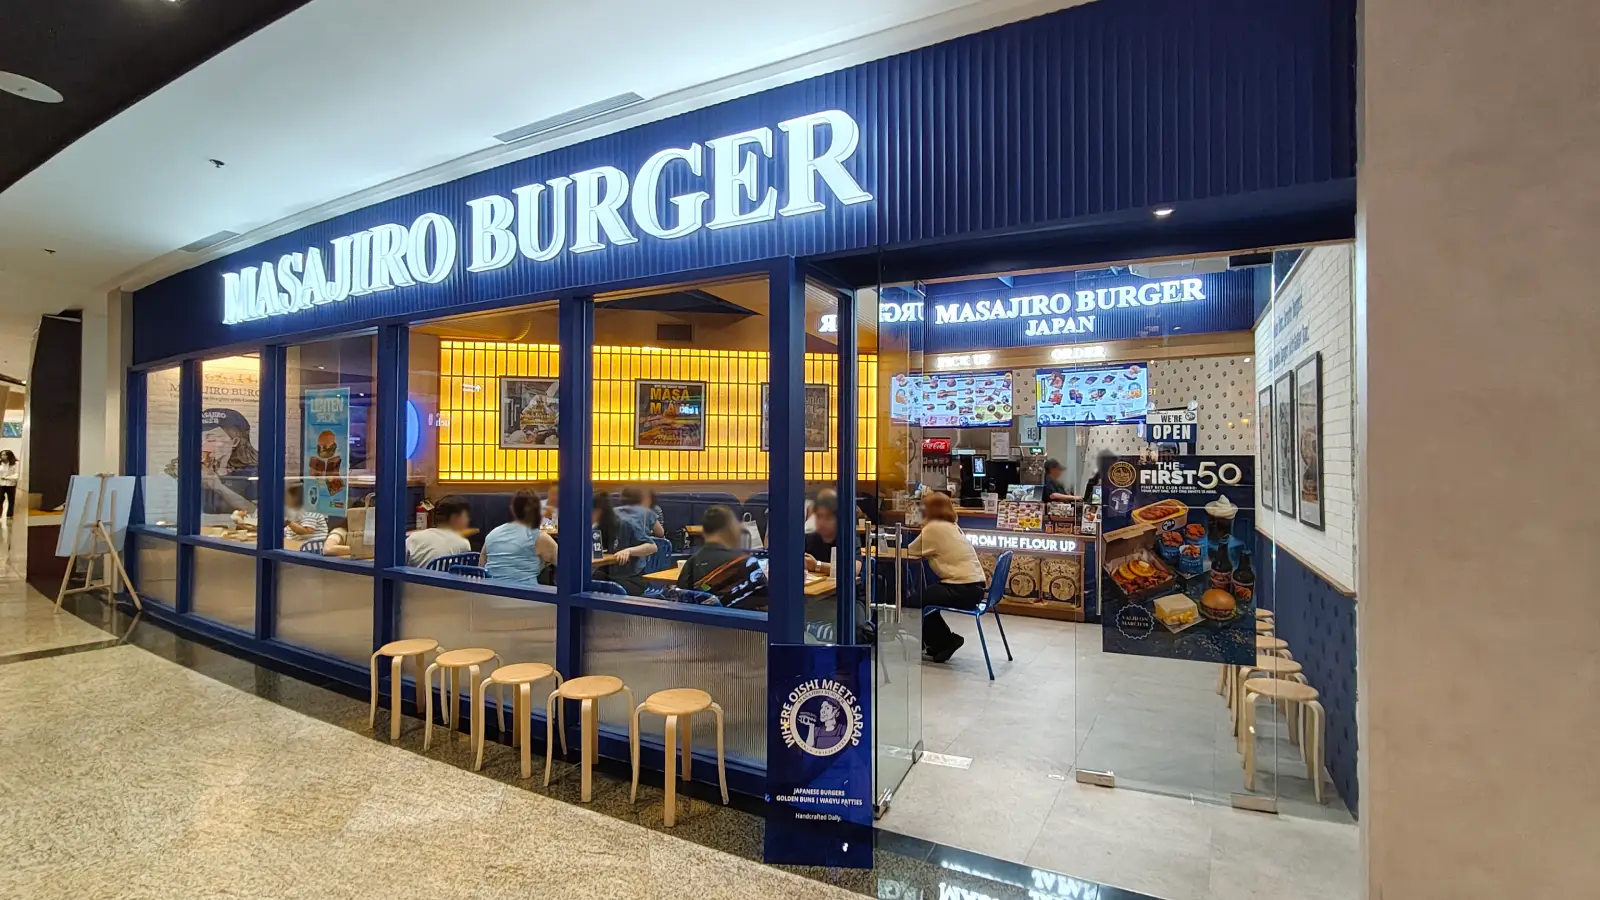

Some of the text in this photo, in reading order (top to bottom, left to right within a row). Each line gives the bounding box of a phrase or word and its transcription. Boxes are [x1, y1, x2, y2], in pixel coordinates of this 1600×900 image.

[222, 109, 874, 326] MASAJIRO BURGER
[935, 278, 1207, 324] MASAJIRO BURGER
[1025, 315, 1095, 337] JAPAN
[972, 354, 991, 366] UP
[1050, 346, 1106, 360] ORDER
[650, 387, 690, 401] MASA
[1161, 415, 1182, 423] WE'RE
[1152, 425, 1191, 440] OPEN
[1156, 462, 1180, 471] THE
[1140, 461, 1242, 489] FIRST 50
[593, 542, 602, 551] 12
[966, 534, 1076, 552] FROM THE FLOUR UP
[780, 702, 796, 749] WHERE
[788, 679, 820, 703] OISHI
[822, 679, 857, 705] MEETS
[851, 705, 864, 747] SARAP
[793, 788, 845, 797] JAPANESE BURGERS
[819, 797, 840, 805] WAGYU
[841, 798, 863, 806] PATTIES
